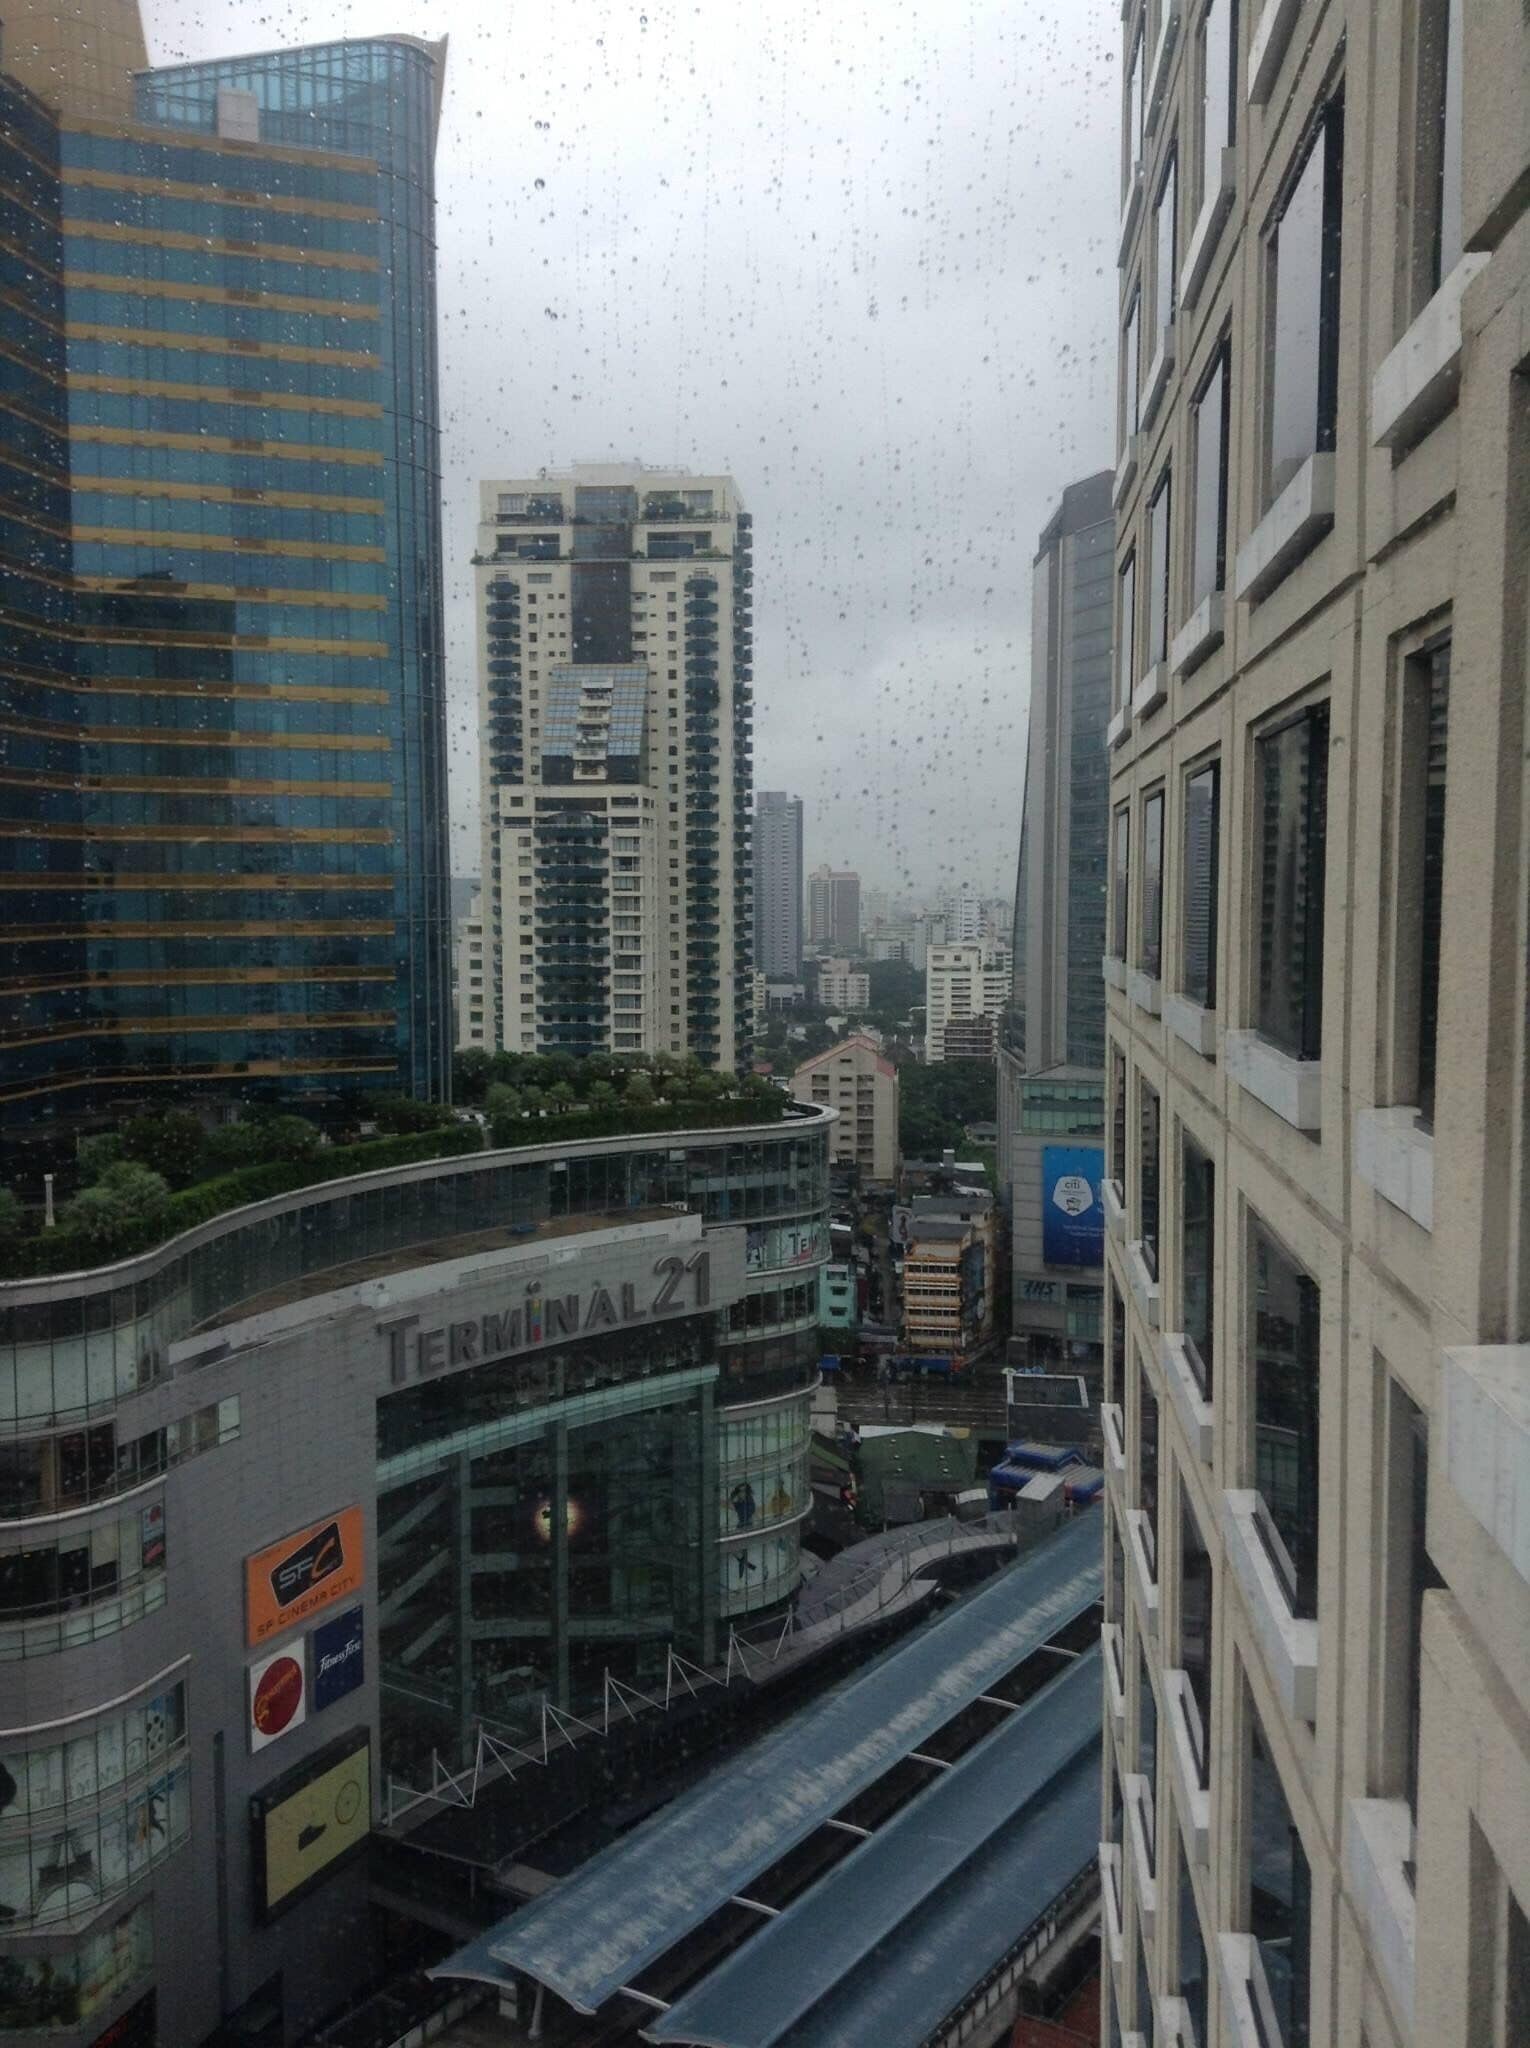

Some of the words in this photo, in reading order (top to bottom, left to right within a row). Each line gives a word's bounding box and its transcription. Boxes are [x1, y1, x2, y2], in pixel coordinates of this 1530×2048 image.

[1065, 1179, 1080, 1189] citi
[256, 1617, 275, 1637] SF
[278, 1592, 327, 1624] CINEMA
[331, 1575, 355, 1597] CITY
[317, 1654, 346, 1679] Fitness
